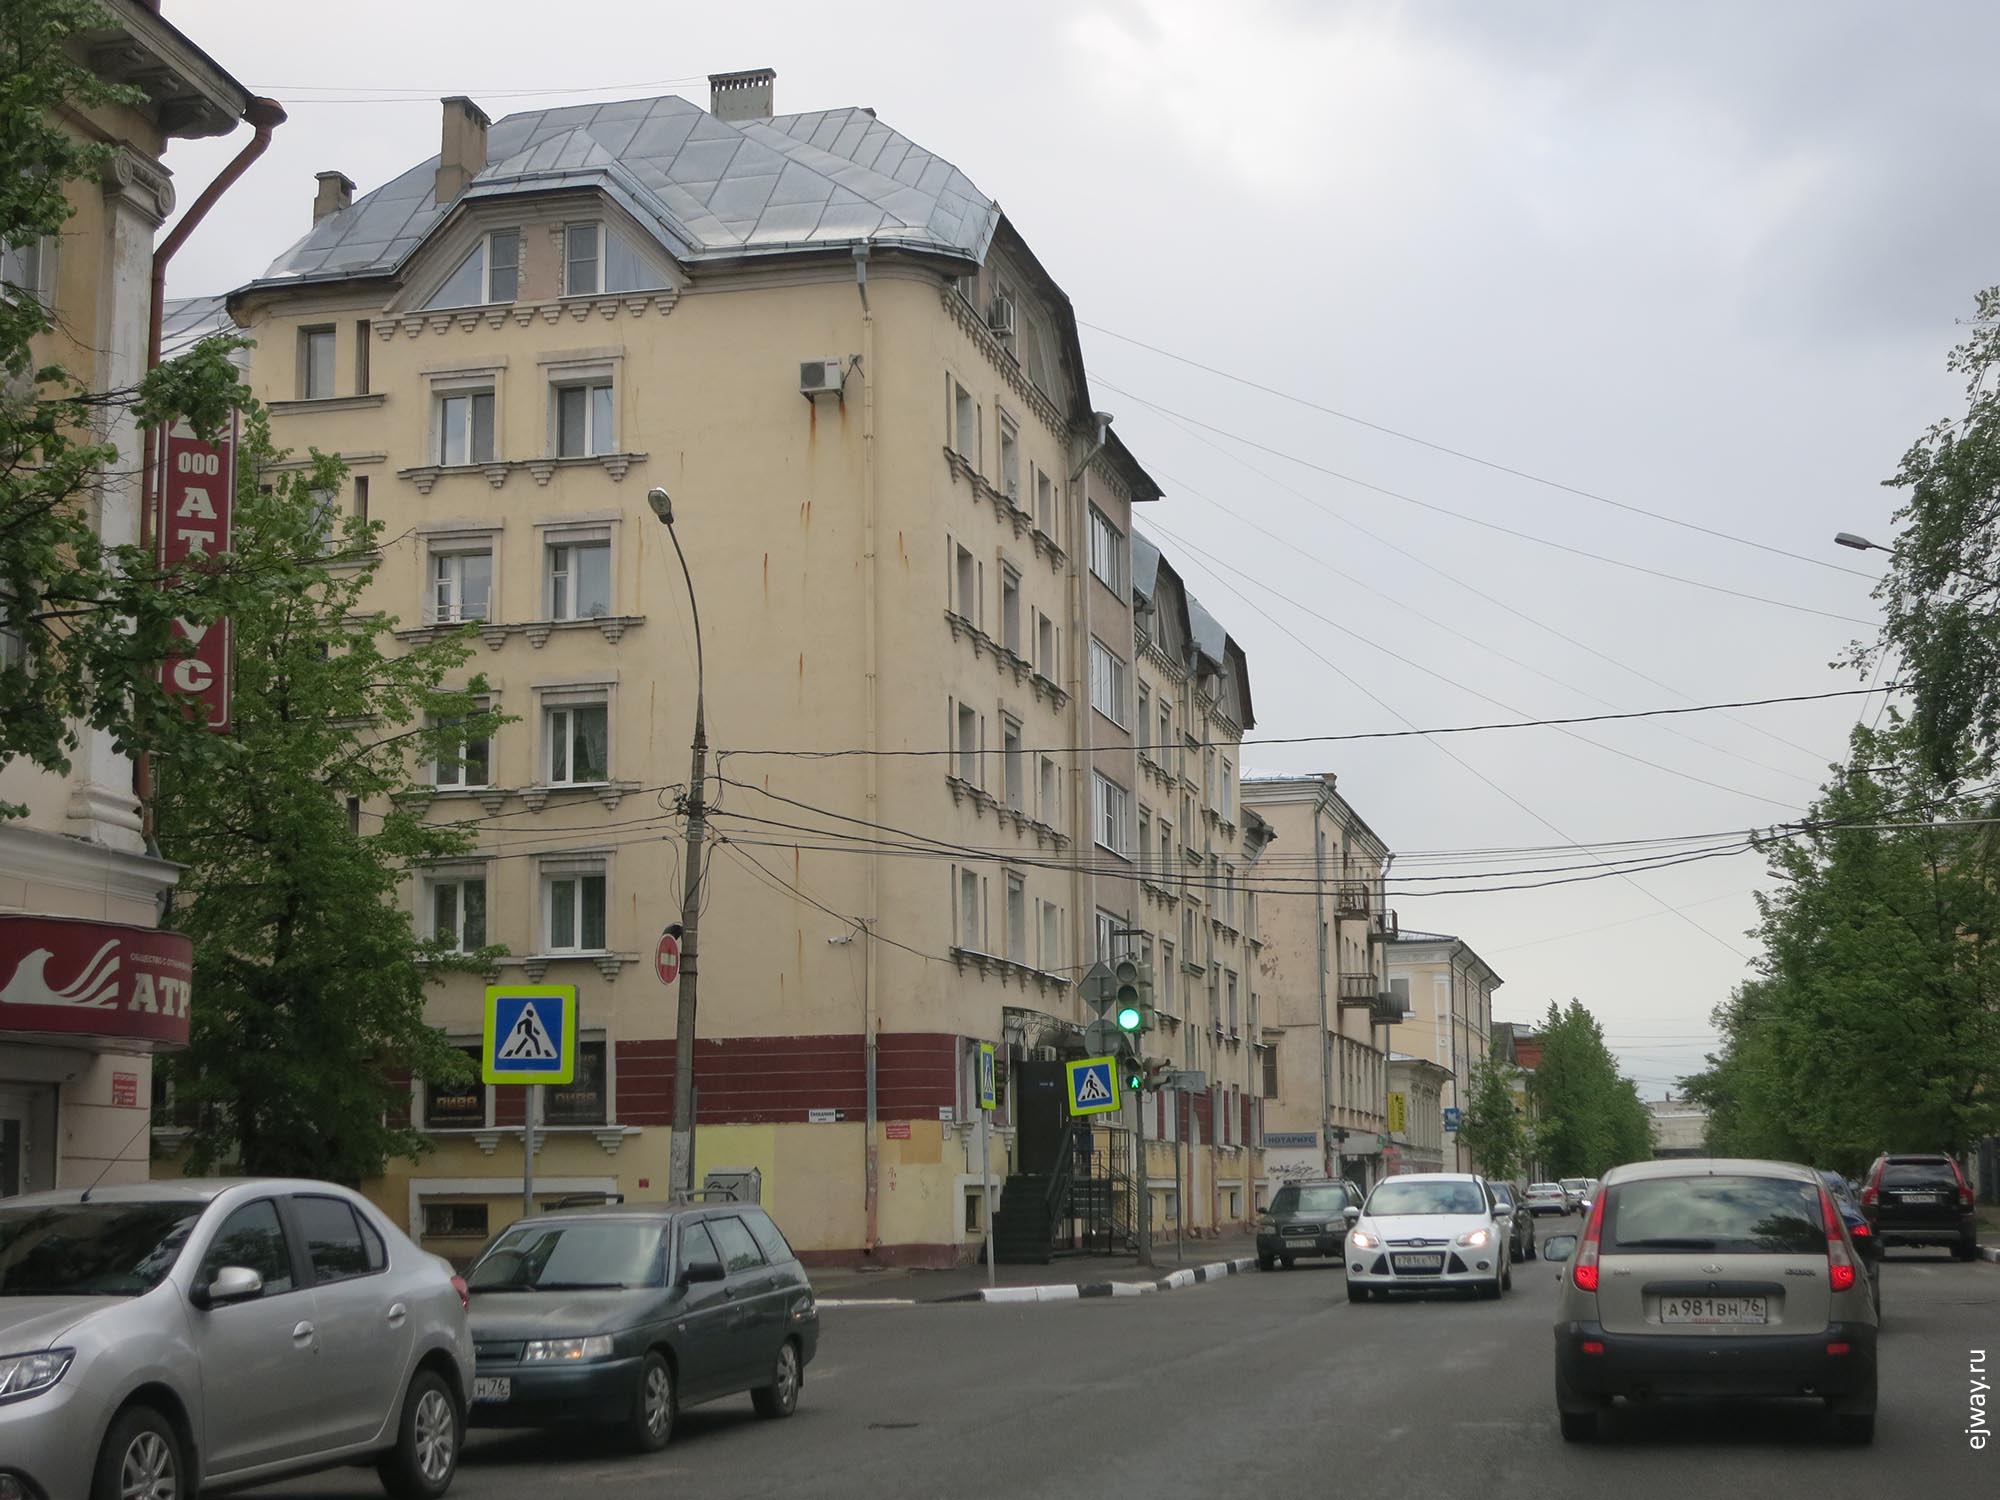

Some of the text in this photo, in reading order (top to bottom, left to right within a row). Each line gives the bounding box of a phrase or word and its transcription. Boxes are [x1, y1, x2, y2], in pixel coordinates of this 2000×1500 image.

[178, 451, 219, 475] ООО
[174, 486, 218, 692] АТУС
[128, 972, 191, 1018] АТР
[1668, 1299, 1760, 1317] А981ВН 76
[490, 1379, 506, 1392] 76
